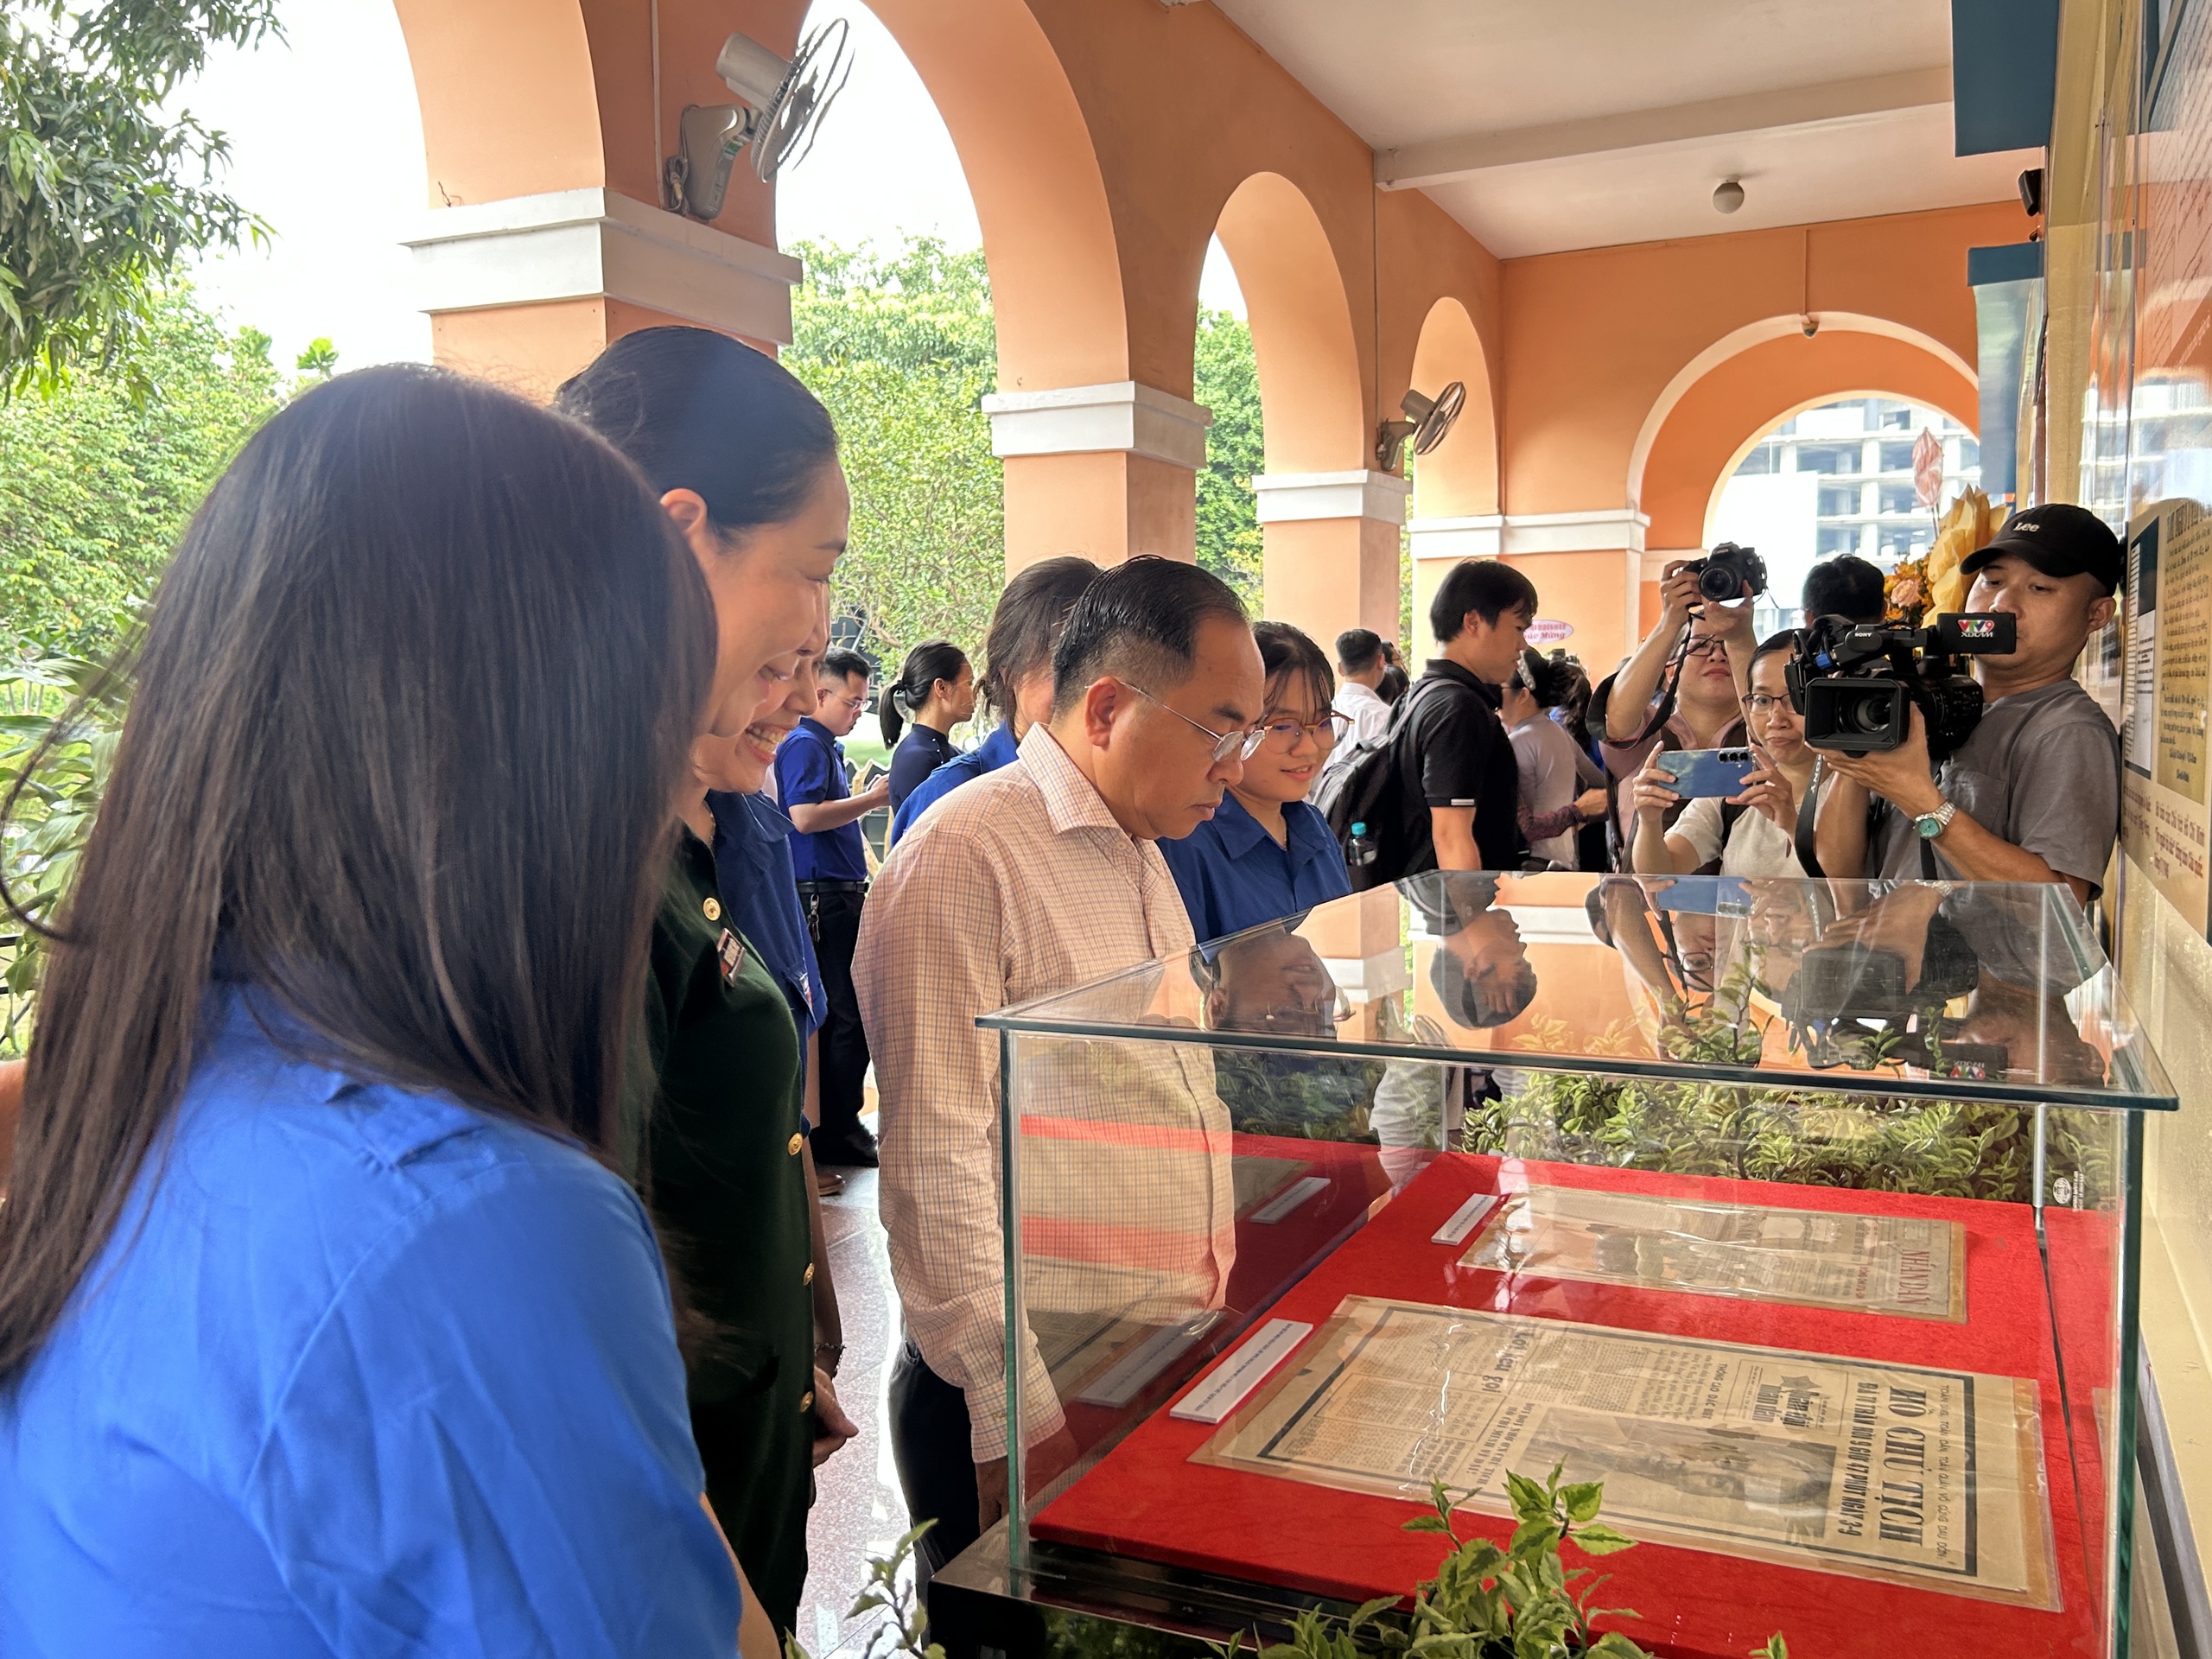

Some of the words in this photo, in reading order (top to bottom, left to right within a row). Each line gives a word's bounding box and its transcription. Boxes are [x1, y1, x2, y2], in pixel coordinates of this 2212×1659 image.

[2012, 522, 2040, 532] Lee
[1958, 620, 1995, 632] VTV9
[1713, 1363, 1727, 1381] THÔNG
[1481, 1375, 1503, 1393] gọi
[1888, 1386, 1932, 1417] HỒ
[1847, 1446, 1871, 1462] GIỜ
[1883, 1427, 1931, 1474] CHỦ
[1845, 1462, 1869, 1473] 47
[1842, 1473, 1869, 1496] PHÚT
[1840, 1496, 1866, 1519] NGÀY
[1875, 1481, 1923, 1544] TỊCH
[1836, 1519, 1863, 1536] 3-9
